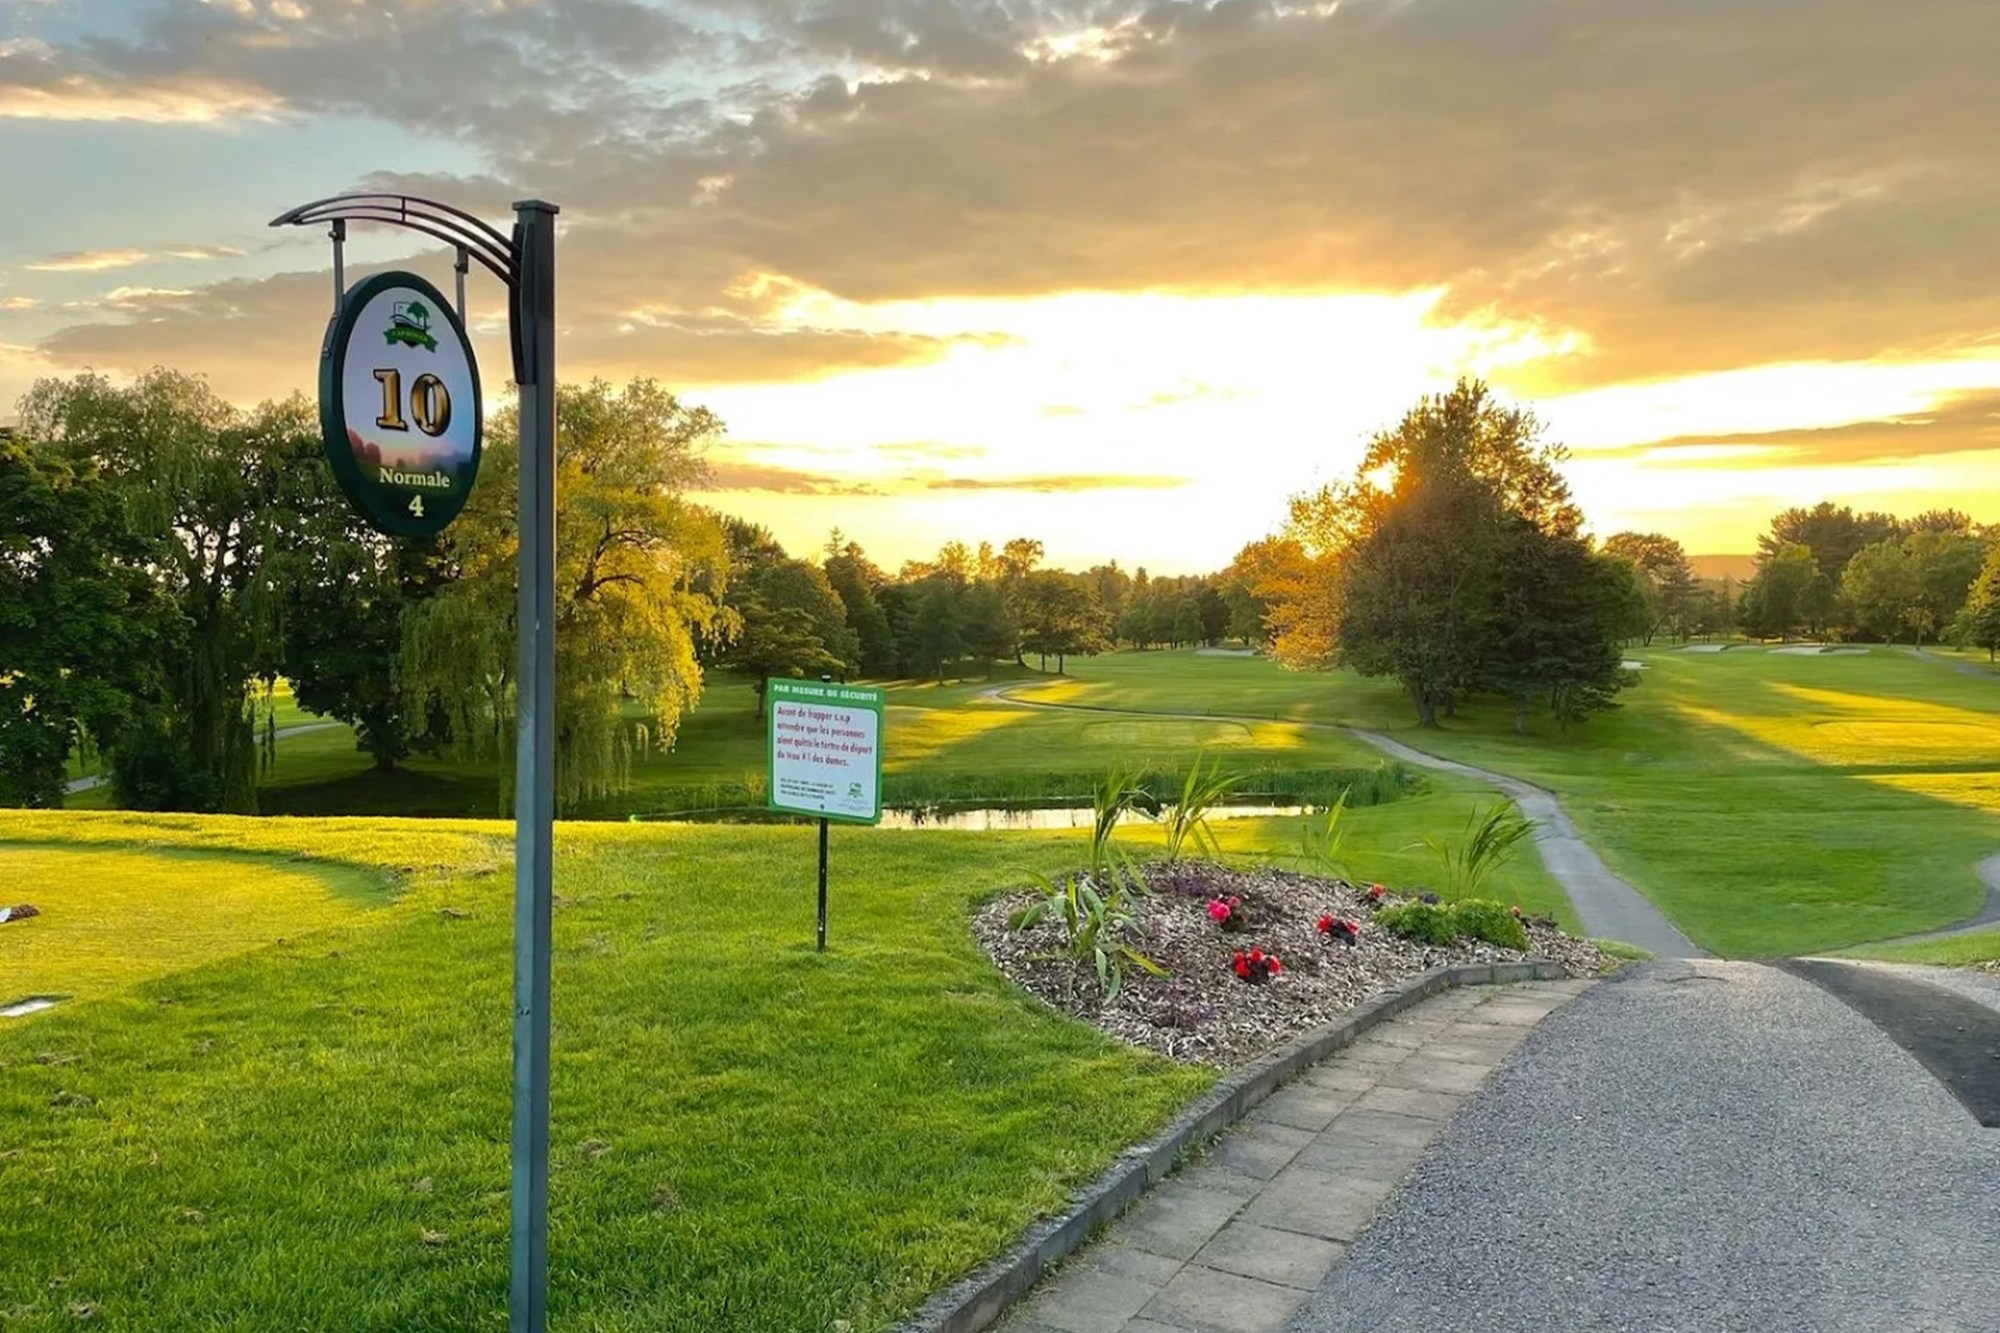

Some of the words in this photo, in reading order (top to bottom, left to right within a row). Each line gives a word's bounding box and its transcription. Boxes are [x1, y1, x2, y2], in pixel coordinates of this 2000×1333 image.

[373, 367, 451, 437] 10
[379, 467, 450, 488] Normale
[408, 494, 425, 518] 4
[774, 684, 789, 693] PAR
[792, 686, 824, 696] MESURE
[827, 689, 838, 698] DE
[778, 706, 797, 716] Avant
[798, 707, 806, 718] de
[808, 708, 832, 721] frapper
[777, 722, 804, 731] attendre
[806, 725, 818, 734] que
[820, 724, 829, 735] les
[831, 729, 865, 739] personnes
[841, 742, 849, 752] de
[777, 749, 785, 759] du
[786, 751, 800, 760] trou
[812, 753, 824, 763] des
